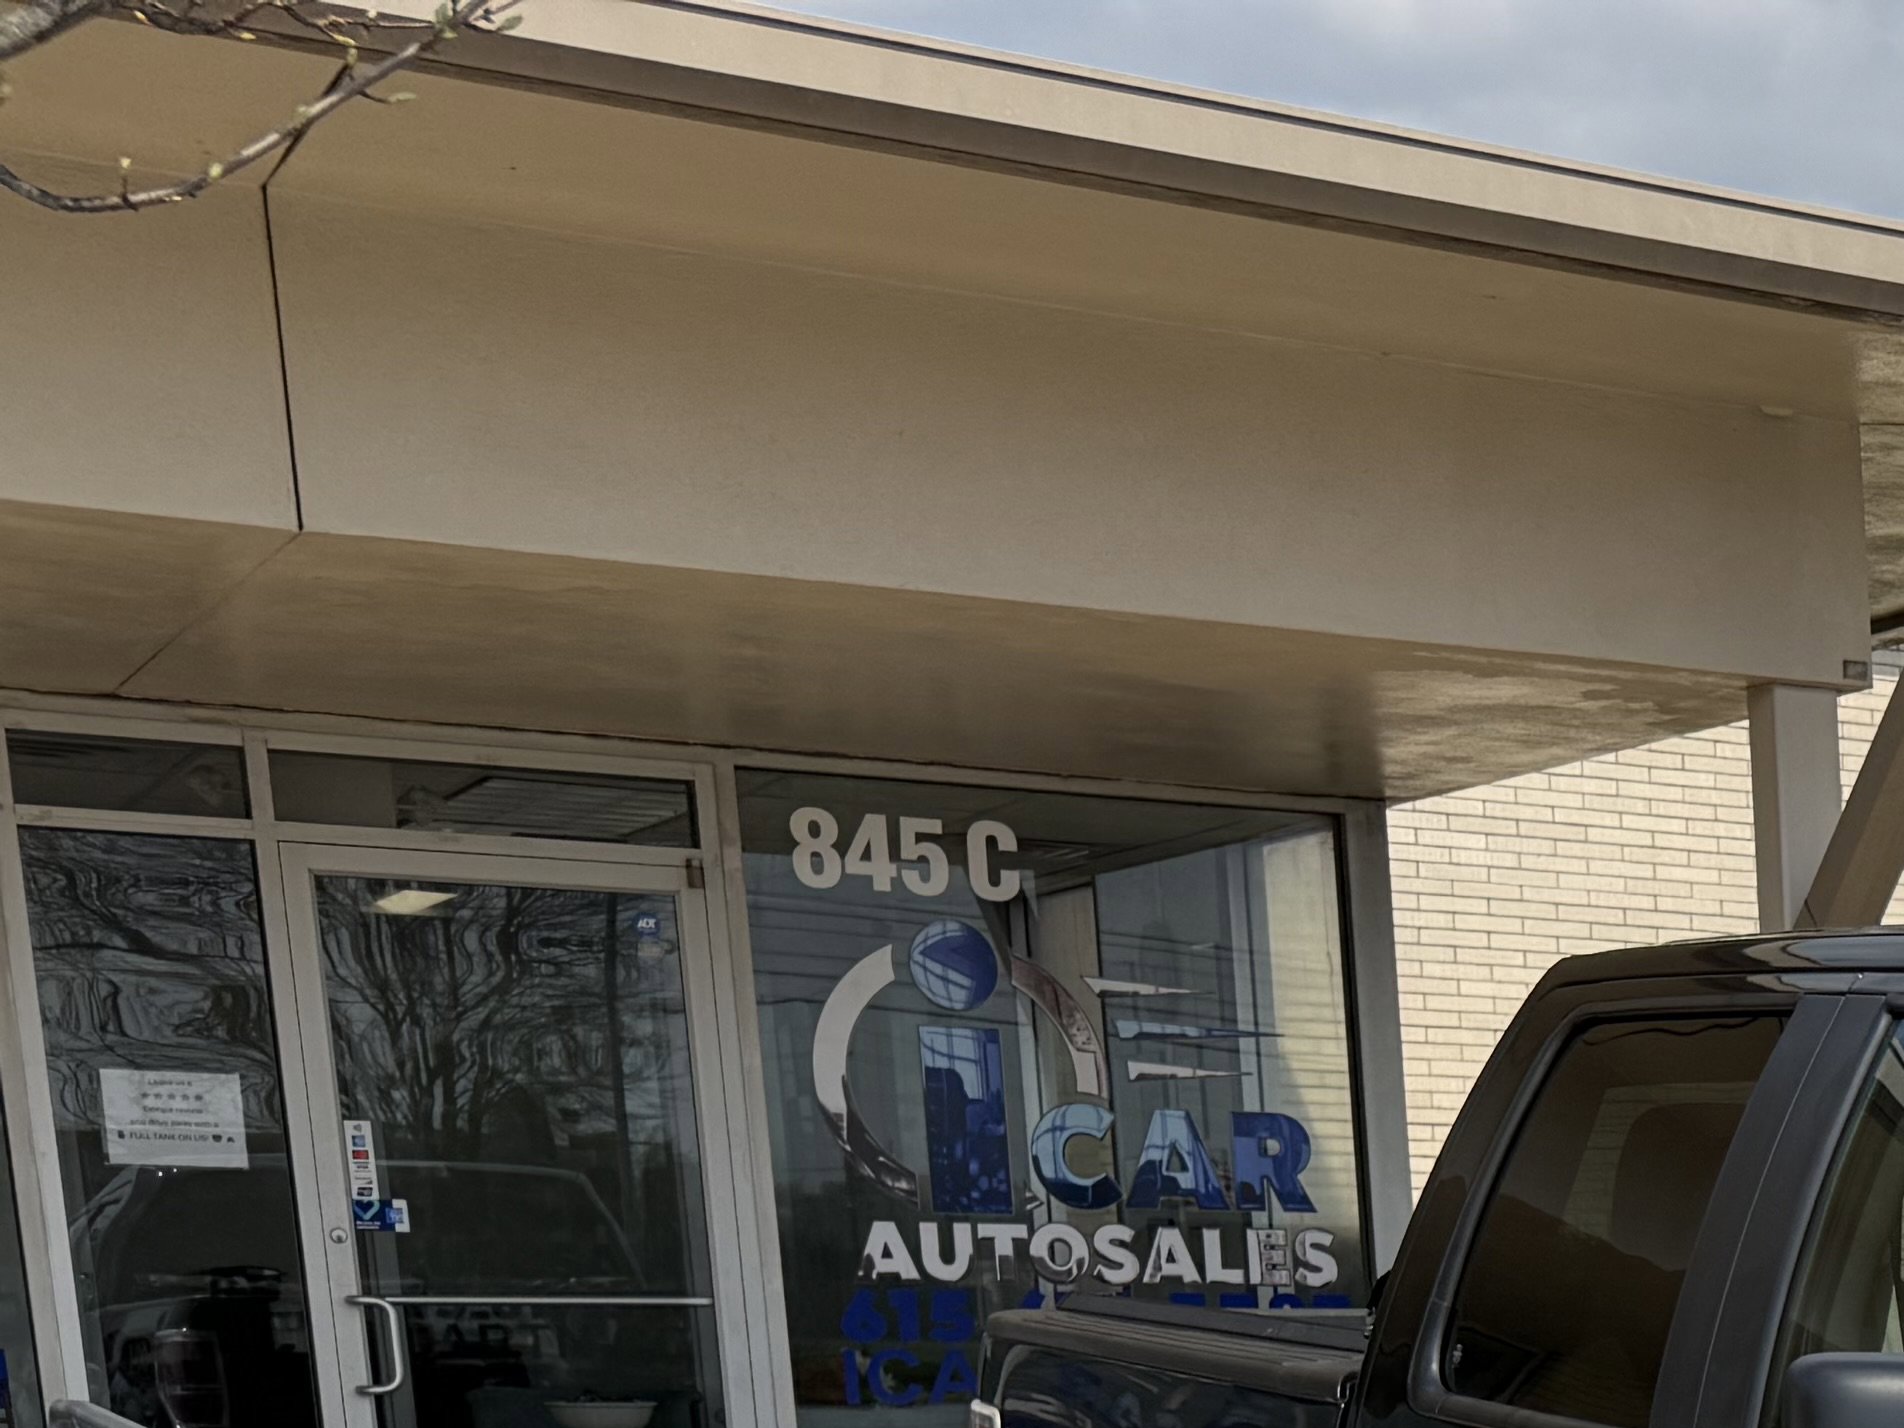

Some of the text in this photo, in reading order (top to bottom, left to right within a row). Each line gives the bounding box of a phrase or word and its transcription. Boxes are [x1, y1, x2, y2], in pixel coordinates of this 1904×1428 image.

[789, 806, 1021, 901] 845 C
[857, 1221, 1338, 1287] AUTOSALES
[840, 1288, 978, 1343] 615
